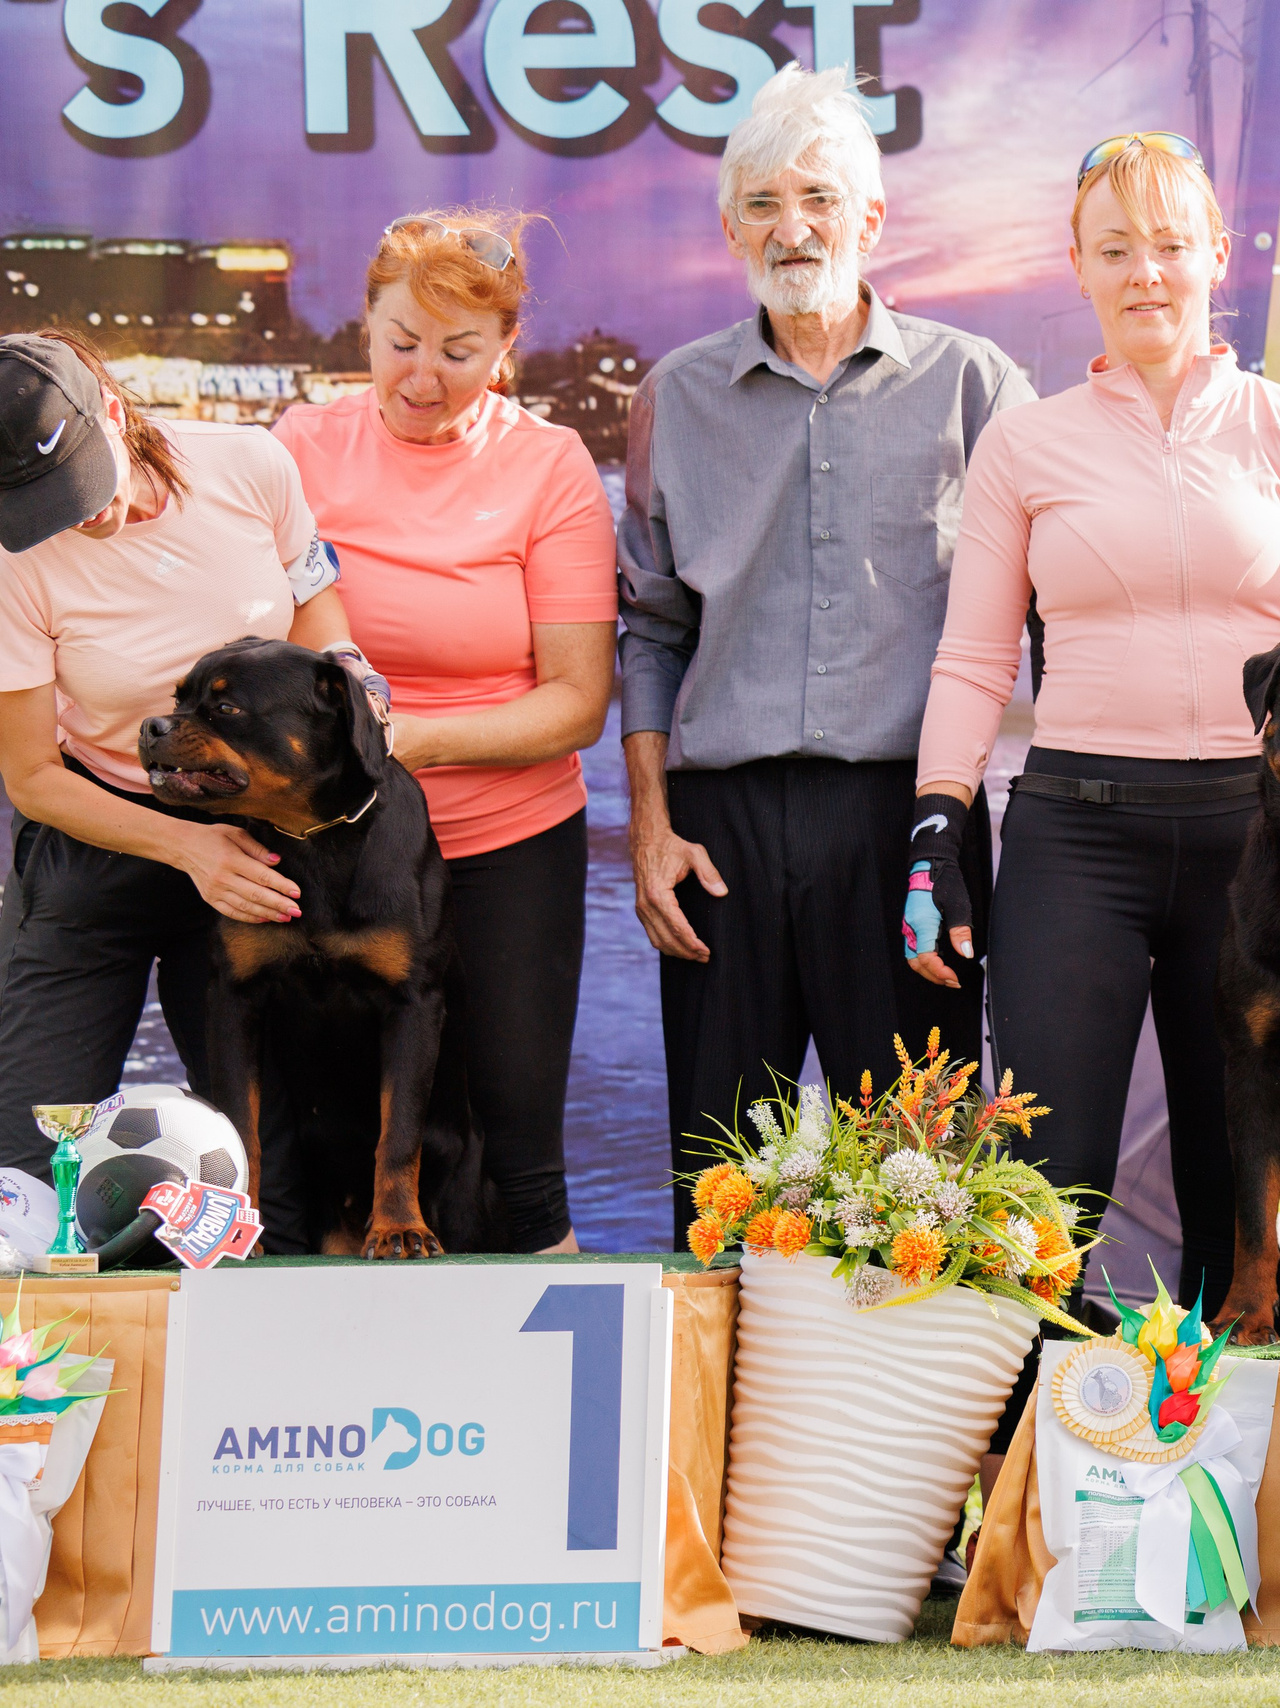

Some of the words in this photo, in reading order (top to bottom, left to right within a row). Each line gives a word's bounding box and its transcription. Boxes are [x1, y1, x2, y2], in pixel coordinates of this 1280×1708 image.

[302, 0, 897, 139] Rest
[181, 1191, 237, 1255] JUMBALL
[518, 1283, 625, 1551] 1
[212, 1464, 264, 1474] КОРМА
[273, 1463, 304, 1473] ДЛЯ
[313, 1462, 365, 1472] СОБАК
[196, 1499, 256, 1512] ЛУЧШЕЕ,
[259, 1498, 284, 1510] ЧТО
[288, 1498, 320, 1510] ЕСТЬ
[323, 1498, 332, 1510] У
[334, 1497, 402, 1509] ЧЕЛОВЕКА
[416, 1496, 442, 1508] ЭТО
[445, 1495, 497, 1507] СОБАКА
[200, 1591, 618, 1642] www.aminodog.ru
